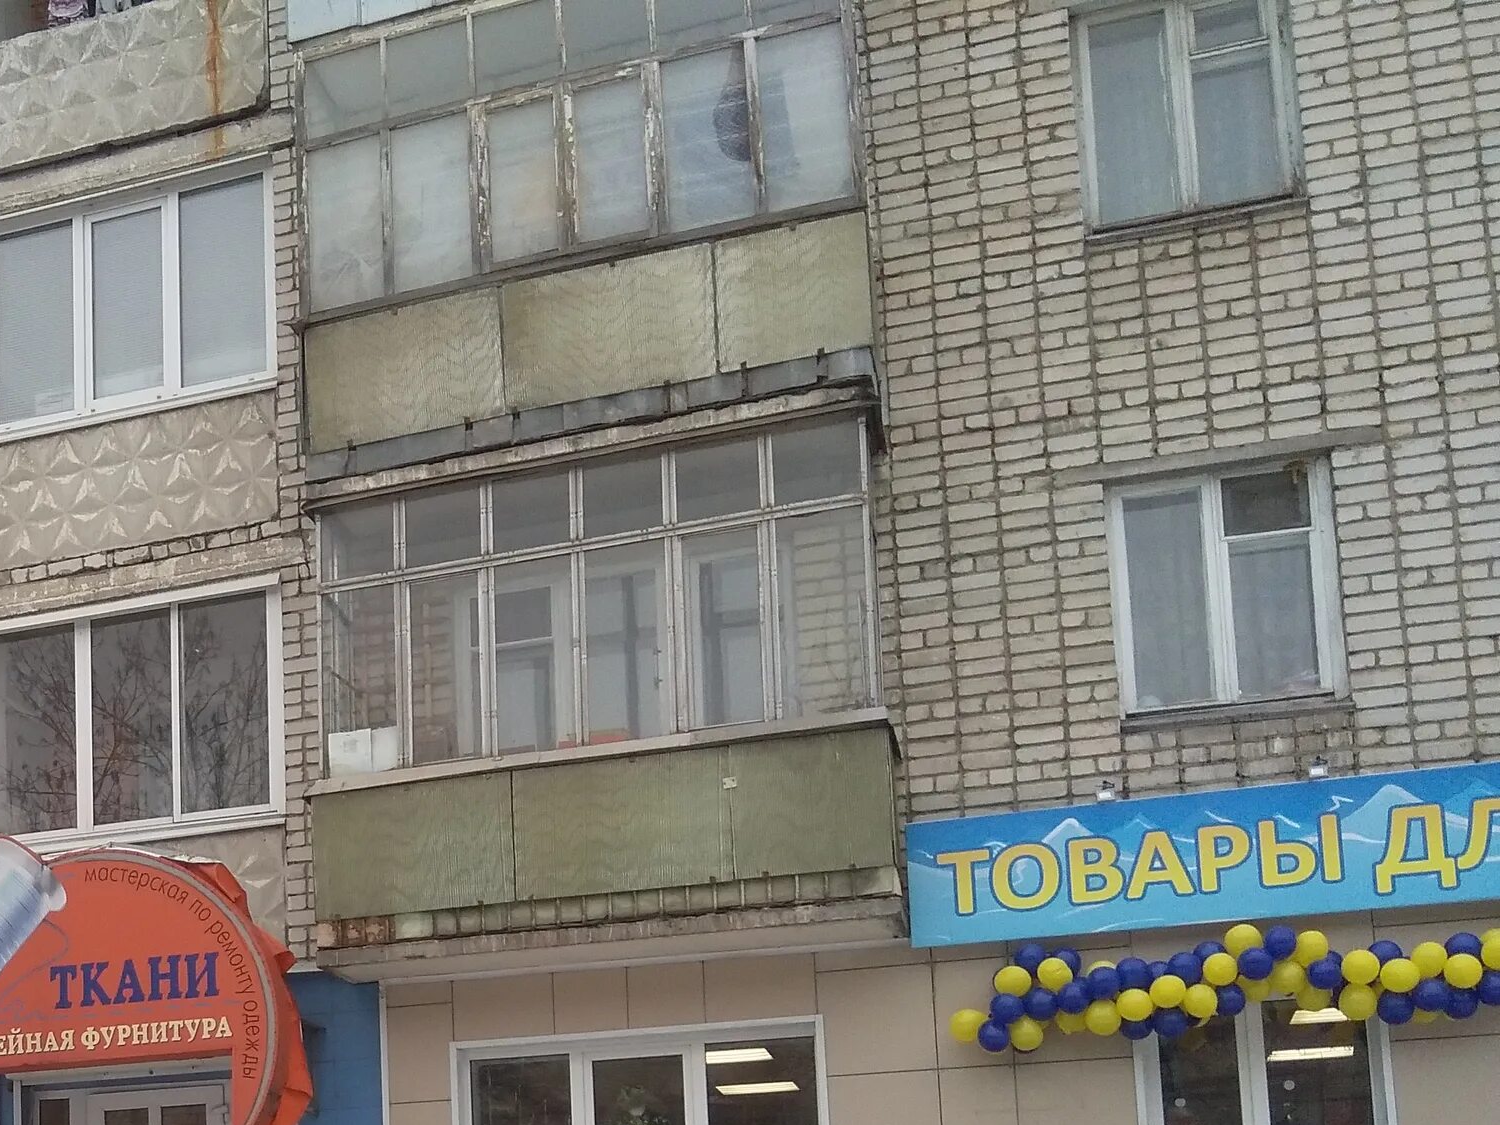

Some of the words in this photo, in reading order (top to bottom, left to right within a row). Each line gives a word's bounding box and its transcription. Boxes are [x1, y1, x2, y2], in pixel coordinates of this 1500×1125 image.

[935, 812, 1344, 916] ТОВАРЫ
[1374, 798, 1500, 896] ДЛ
[50, 951, 220, 1010] ТКАНИ
[84, 866, 189, 905] мастерская
[189, 898, 212, 922] по
[204, 919, 256, 995] ремонту
[241, 1000, 260, 1080] одежды
[80, 1016, 233, 1051] ФУРНИТУРА
